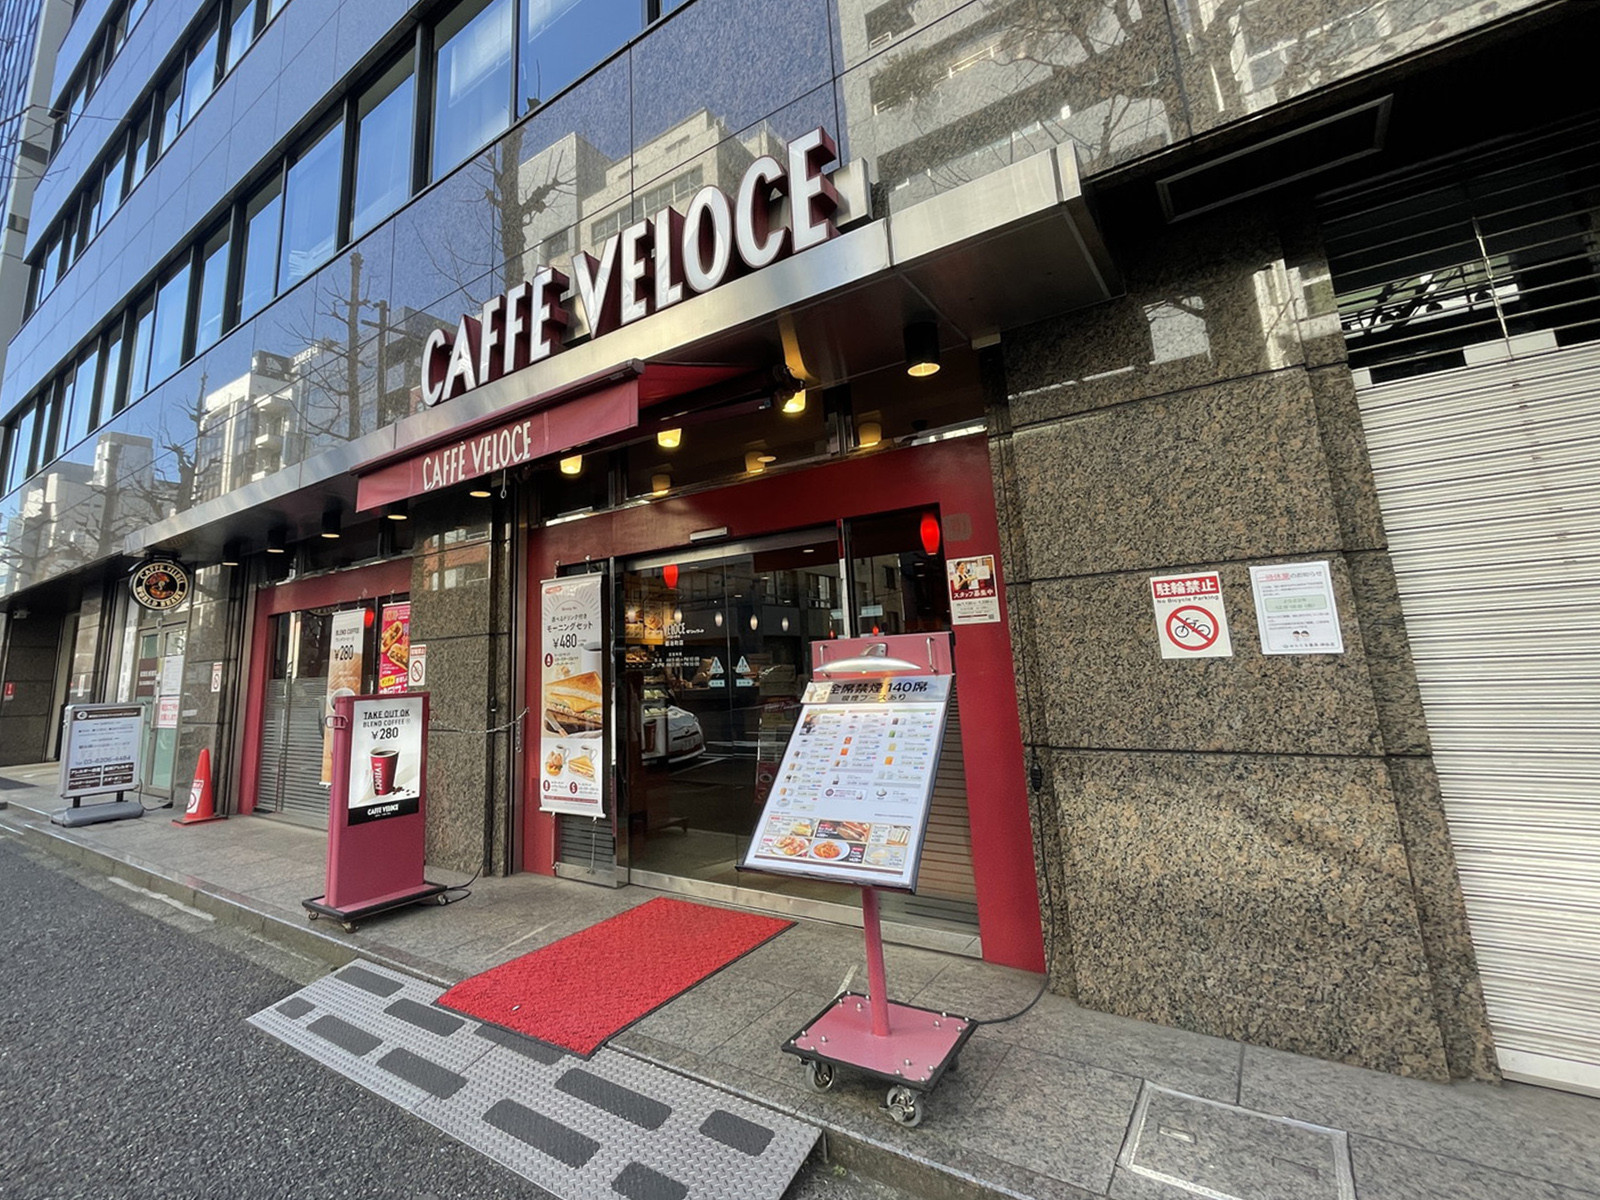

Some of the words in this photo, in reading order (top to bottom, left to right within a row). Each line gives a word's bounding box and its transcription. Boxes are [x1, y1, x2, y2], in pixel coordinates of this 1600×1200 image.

[572, 126, 837, 339] VELOCE
[471, 421, 532, 474] VELOCE
[1156, 579, 1217, 596] 駐輪禁止
[547, 621, 593, 633] モーニングセット
[552, 633, 577, 649] ¥480
[334, 644, 354, 661] ¥280
[830, 681, 884, 695] 全席禁煙
[887, 681, 928, 693] 140席
[363, 710, 383, 720] TAKE
[384, 709, 398, 719] OUT
[400, 709, 410, 718] OK
[363, 720, 382, 728] BLEND
[383, 718, 405, 727] COFFEE
[371, 727, 399, 740] ¥280
